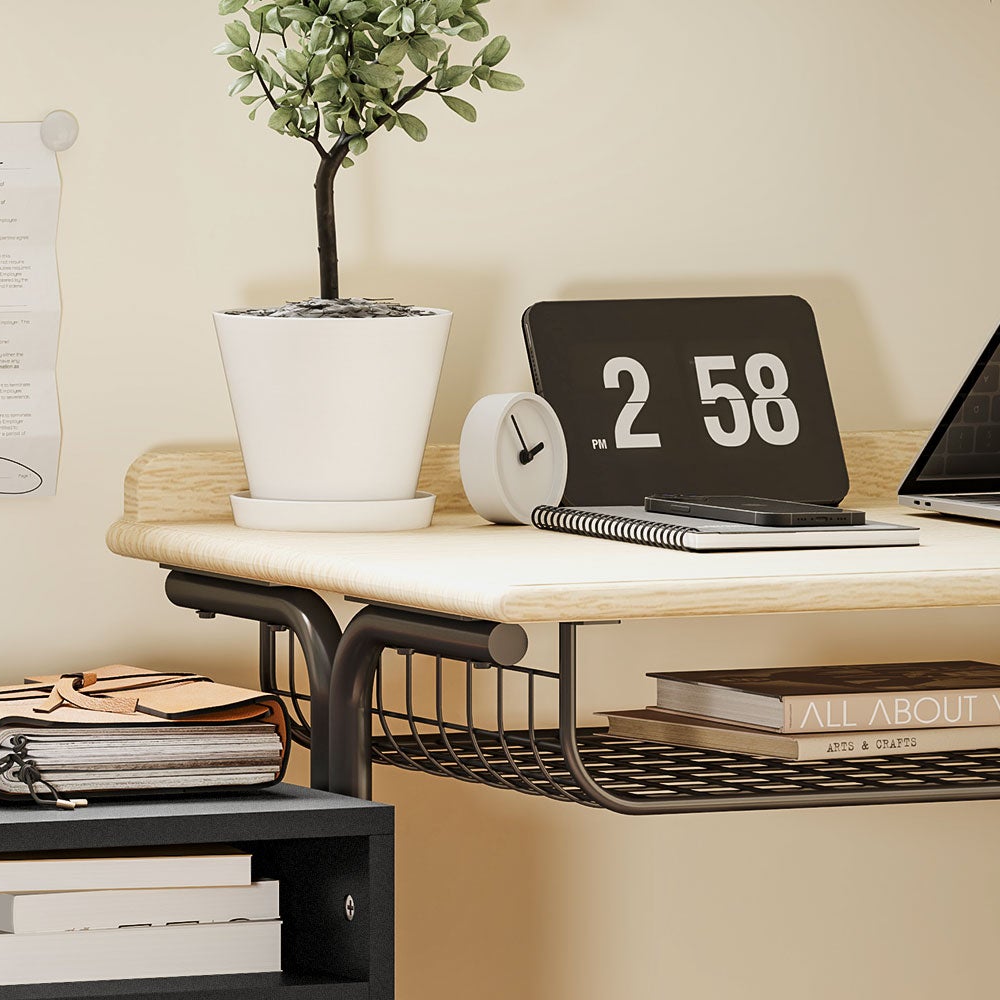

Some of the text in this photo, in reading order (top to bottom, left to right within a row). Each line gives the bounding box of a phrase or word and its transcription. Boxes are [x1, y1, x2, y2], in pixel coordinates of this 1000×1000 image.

[603, 352, 799, 449] 2 58
[591, 438, 608, 450] PM
[800, 700, 857, 728] ALL
[868, 695, 978, 725] ABOUT
[827, 738, 917, 753] ARTS & CRAFTS
